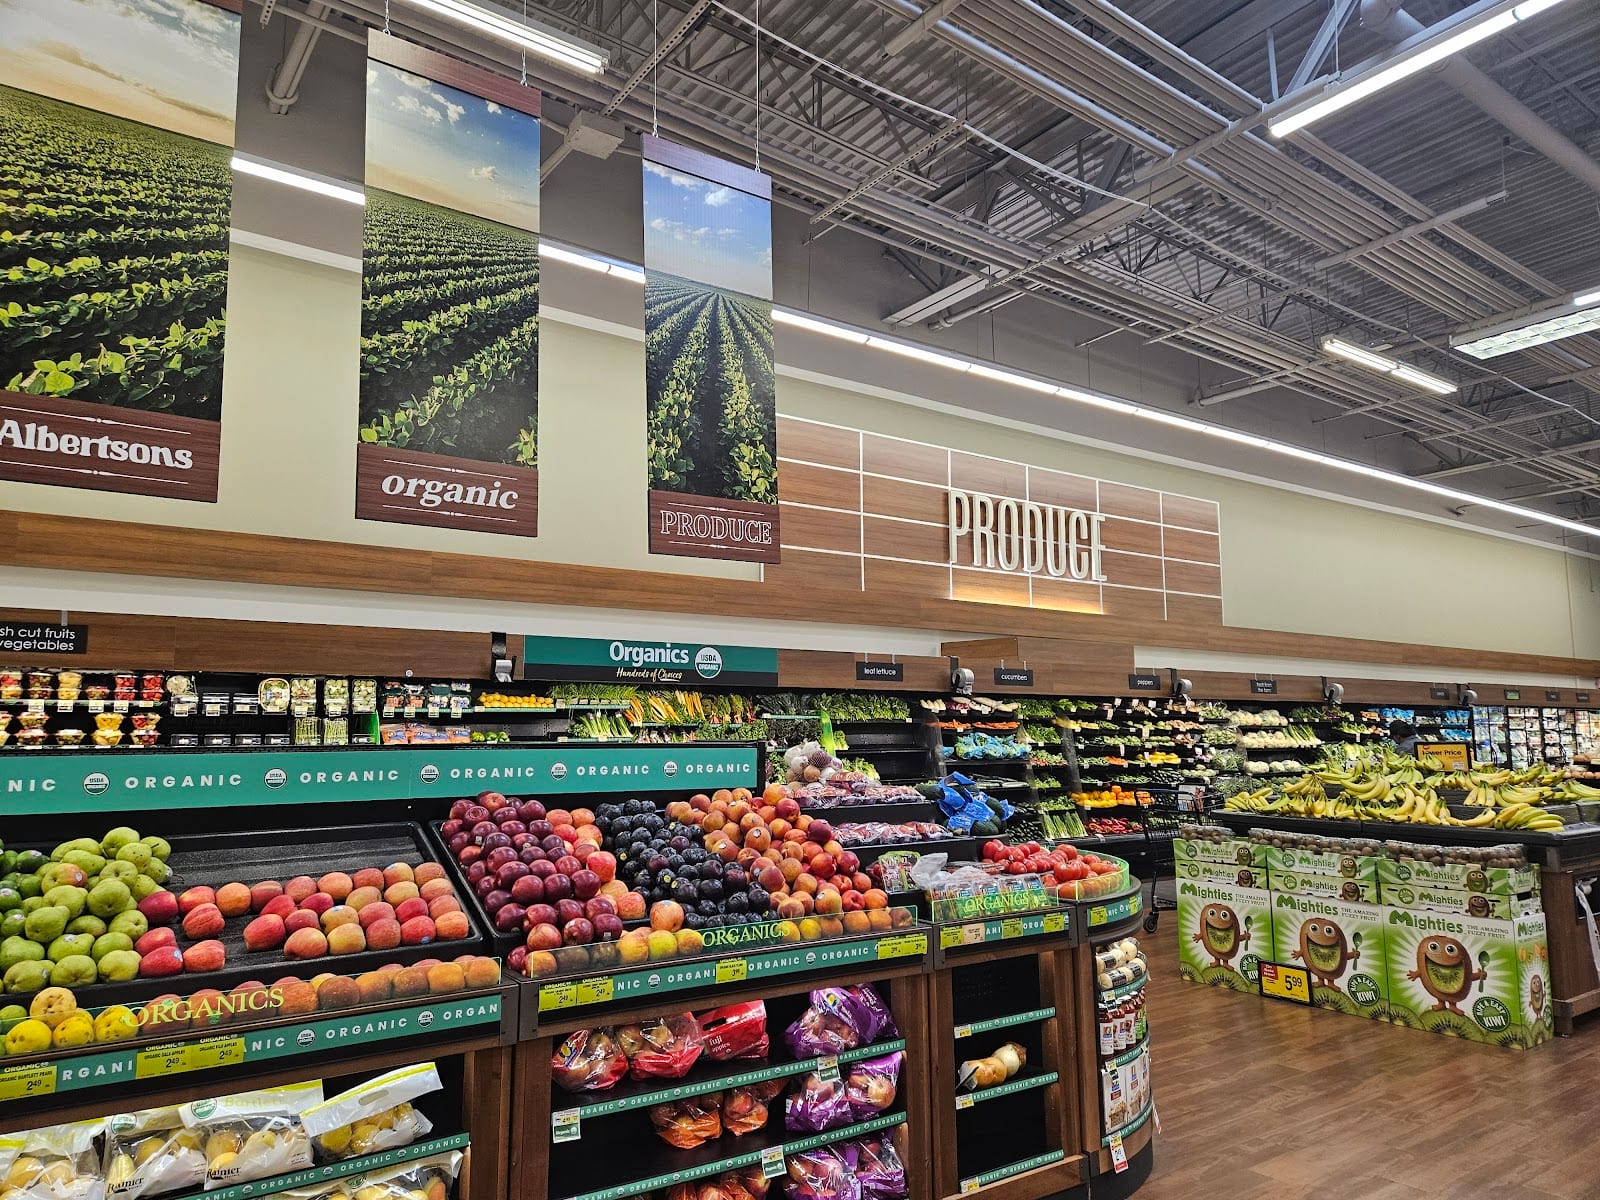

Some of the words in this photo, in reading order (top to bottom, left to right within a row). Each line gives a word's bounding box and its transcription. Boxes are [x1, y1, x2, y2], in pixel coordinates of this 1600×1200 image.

[0, 419, 193, 469] Albertsons
[381, 474, 519, 510] organic
[660, 509, 772, 545] PRODUCE
[949, 490, 1108, 582] PRODUCE
[18, 627, 41, 638] cut
[45, 627, 76, 639] fruits
[609, 641, 689, 667] Organics
[700, 654, 717, 662] USDA
[616, 666, 650, 679] Hundreds
[649, 669, 659, 683] of
[658, 668, 683, 680] Choices
[876, 667, 897, 676] lettuce
[299, 768, 400, 783] ORGANIC
[450, 767, 535, 779] ORGANIC
[576, 764, 650, 776] ORGANIC
[685, 763, 751, 774] ORGANIC
[124, 773, 242, 789] ORGANIC
[1299, 855, 1337, 869] Mighties
[1202, 867, 1235, 879] Mighties
[1415, 868, 1461, 883] Mighties
[1180, 882, 1233, 901] Mighties
[1300, 878, 1339, 892] Mighties
[965, 891, 1029, 913] ORGANICS
[1276, 894, 1339, 916] Mighties
[1418, 891, 1464, 906] Mighties
[1389, 909, 1464, 934] Mighties
[702, 920, 790, 947] ORGANICS
[1480, 925, 1509, 935] AMAZING
[1517, 921, 1545, 938] Mighties
[821, 947, 869, 961] ORGANIC
[748, 956, 800, 971] ORGANIC
[612, 979, 641, 991] NIC
[1356, 990, 1377, 1002] KIWI
[123, 987, 285, 1028] ORGANICS
[325, 1017, 408, 1039] ORGANIC
[1483, 1015, 1506, 1028] KIWI
[145, 1042, 178, 1052] ORGANIC
[4, 1062, 42, 1073] ORGANIC
[784, 1060, 817, 1072] ORGANIC
[737, 1070, 772, 1083] ORGANIC
[26, 1079, 42, 1091] 249
[685, 1081, 722, 1094] ORGANIC
[630, 1092, 669, 1105] ORGANIC
[830, 1126, 861, 1139] ORGANIC
[413, 1137, 461, 1154] ORGANIC
[785, 1139, 817, 1152] ORGANIC
[340, 1153, 391, 1172] ORGANIC
[206, 1166, 241, 1179] Rainier
[684, 1164, 721, 1178] ORGANIC
[107, 1177, 145, 1194] Rainier
[260, 1172, 315, 1190] ORGANIC
[629, 1177, 668, 1192] ORGANIC
